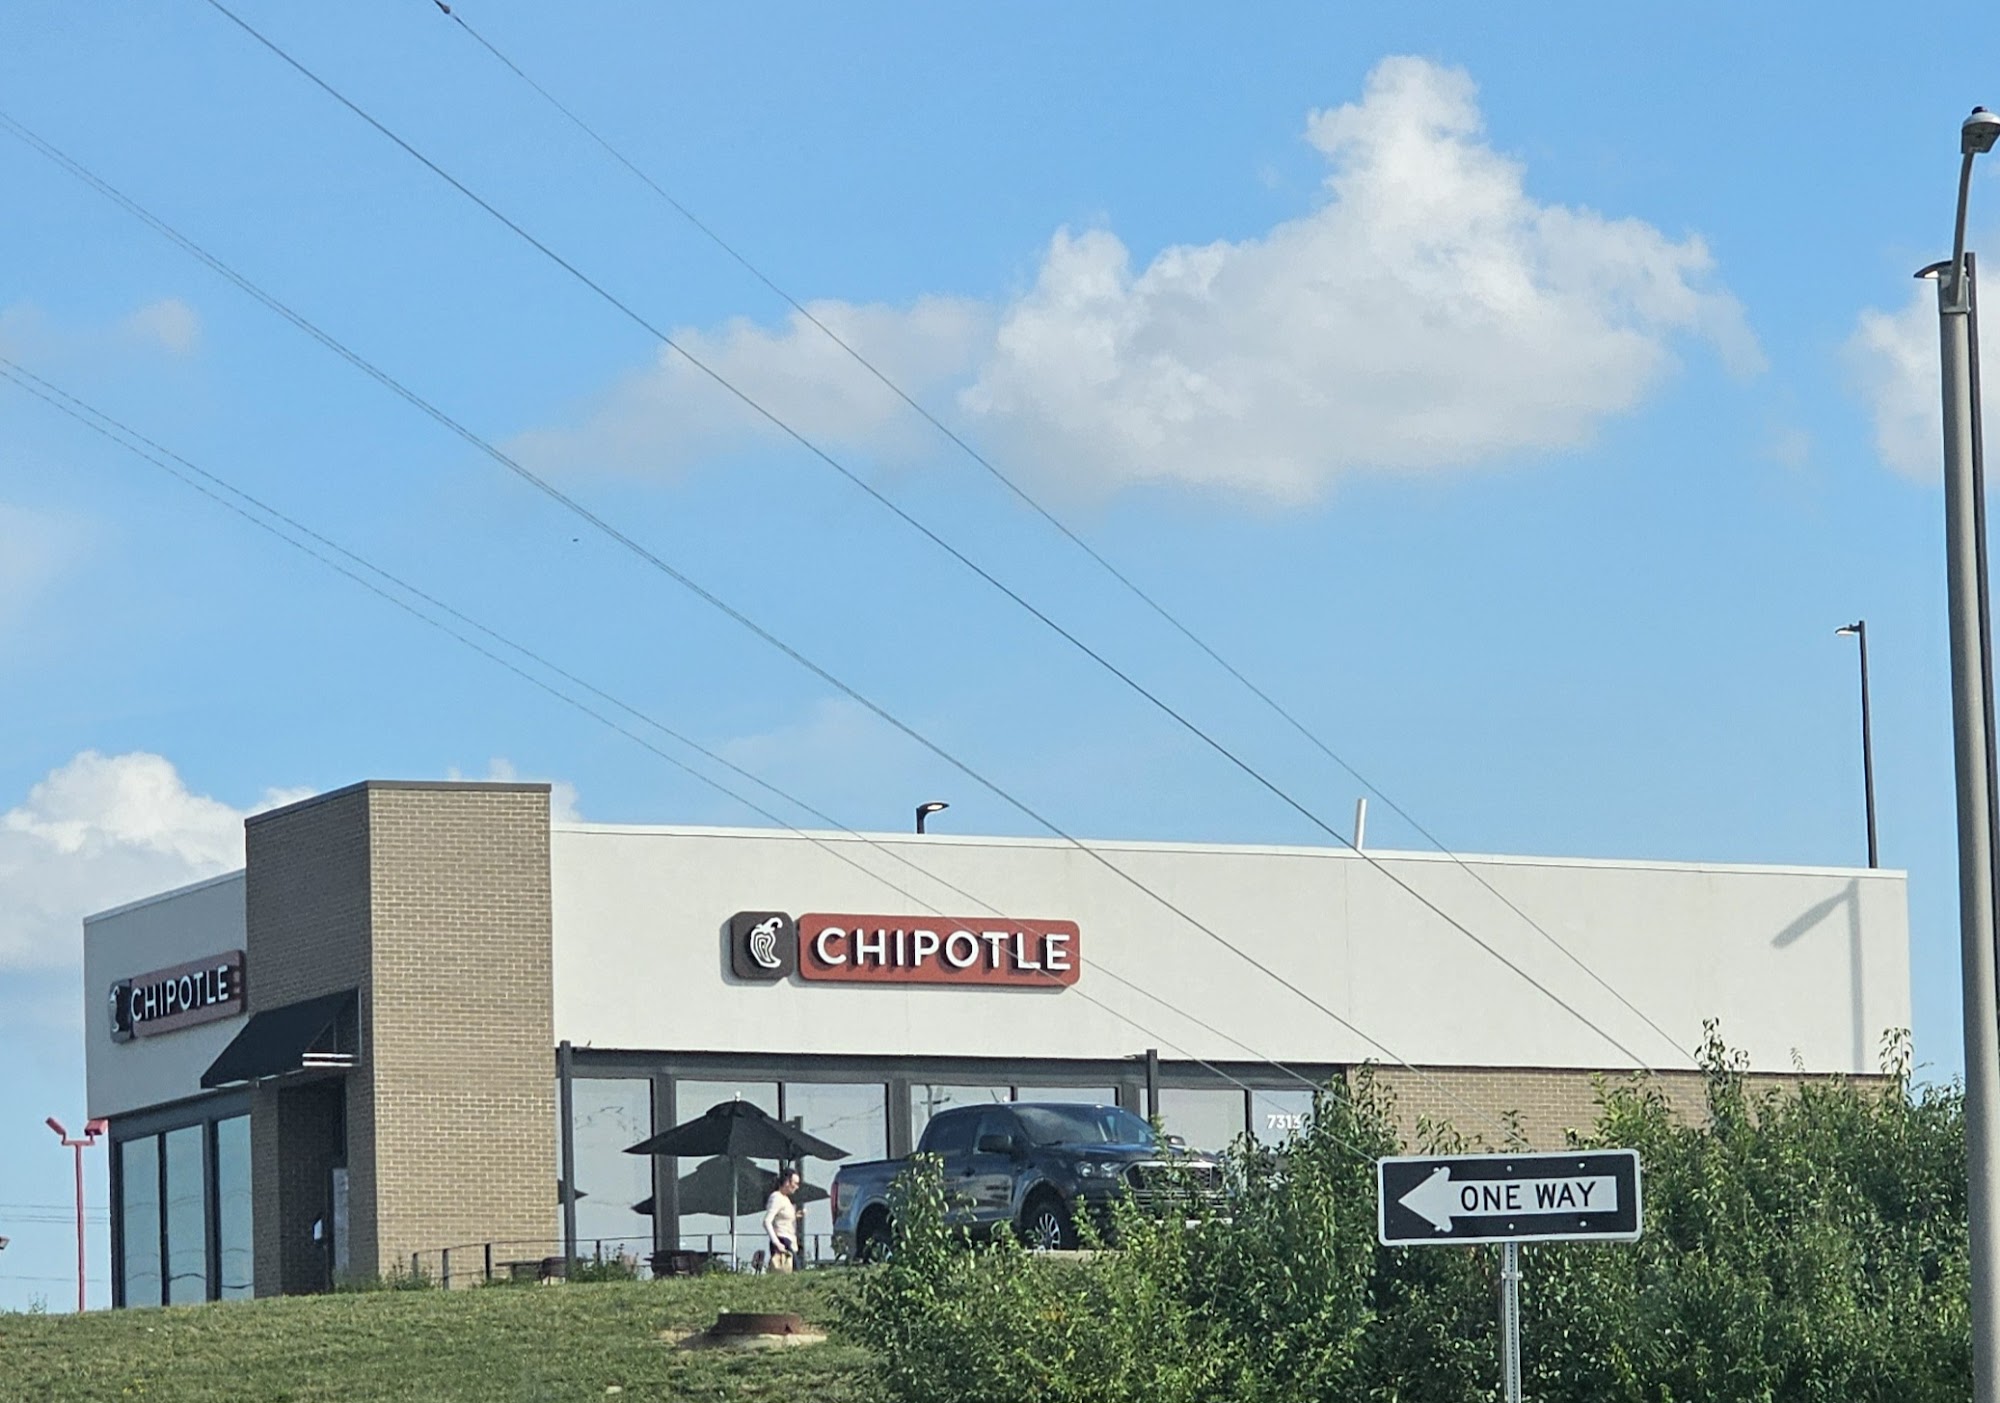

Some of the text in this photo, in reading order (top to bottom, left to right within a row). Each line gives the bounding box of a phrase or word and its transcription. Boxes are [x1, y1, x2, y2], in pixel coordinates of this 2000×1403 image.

[816, 927, 1071, 971] CHIPOTLE
[130, 964, 230, 1022] CHIPOTLE
[1460, 1181, 1597, 1212] ONE WAY
